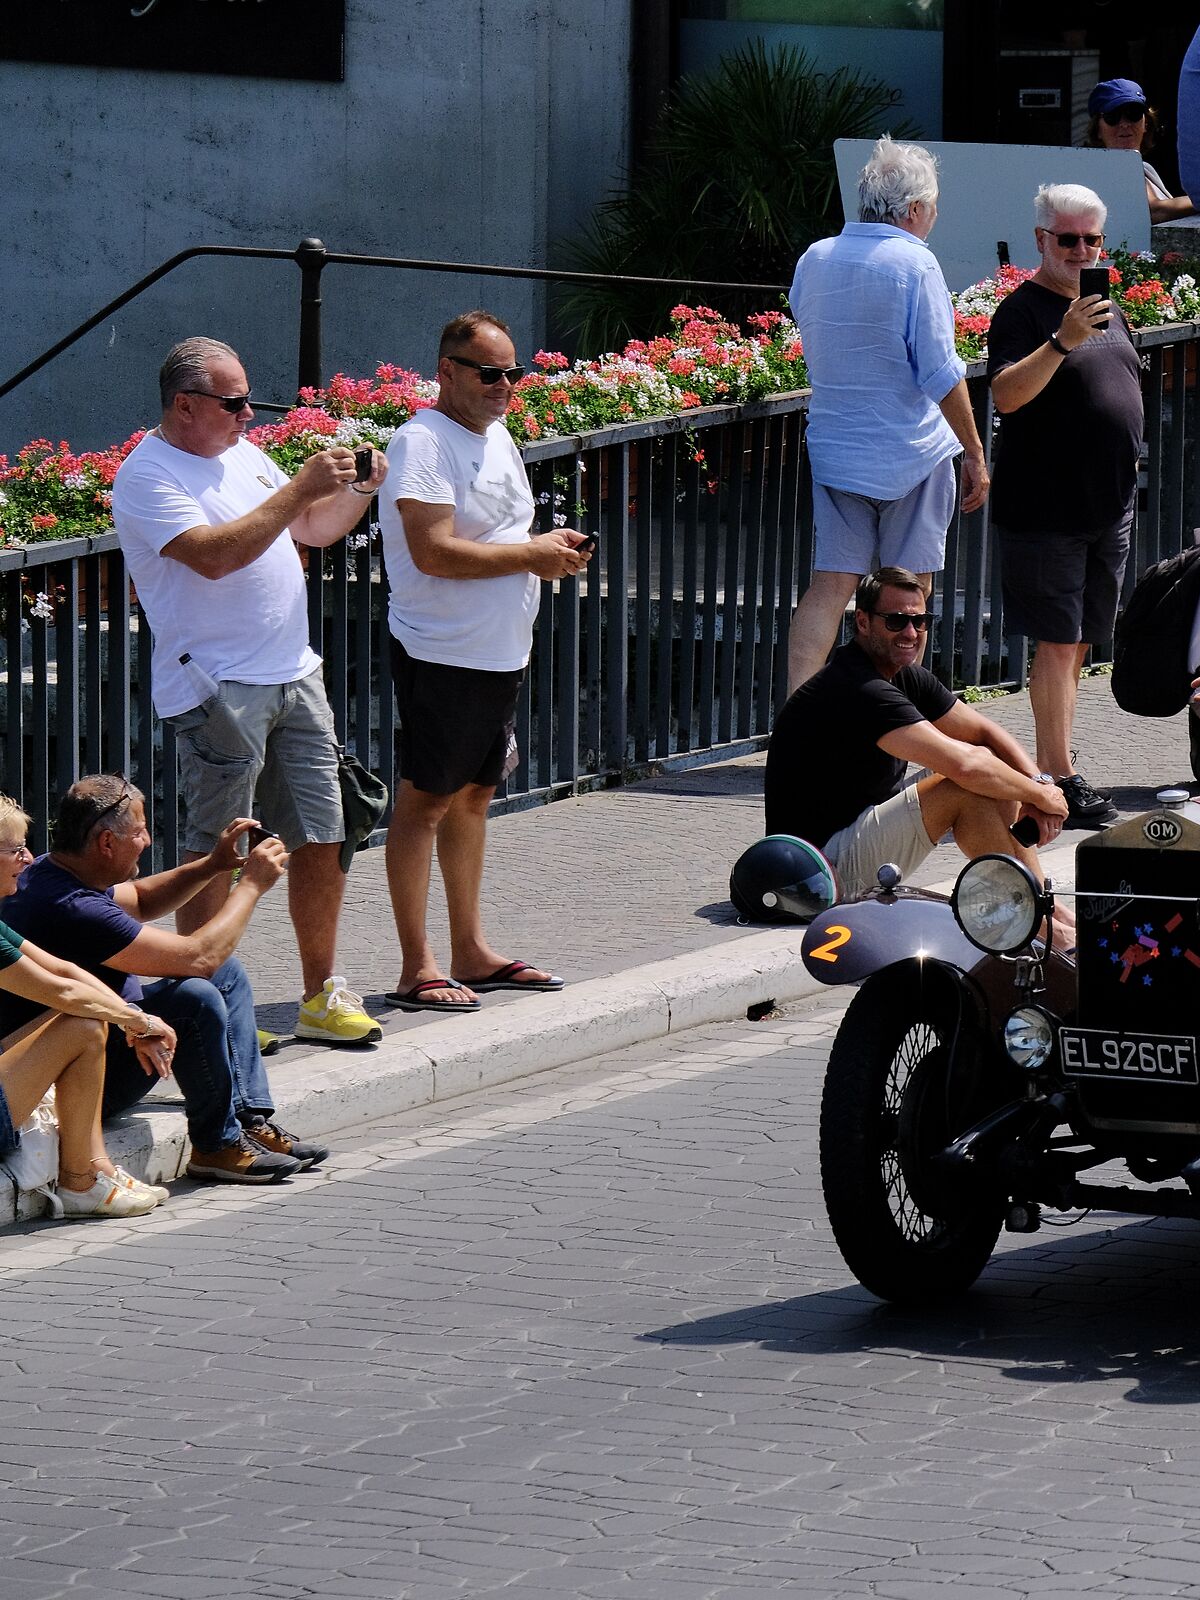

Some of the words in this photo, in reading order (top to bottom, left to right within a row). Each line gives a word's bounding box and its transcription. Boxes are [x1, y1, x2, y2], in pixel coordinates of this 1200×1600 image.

[1150, 822, 1174, 837] OM
[809, 925, 852, 963] 2
[1063, 1036, 1191, 1075] EL926CF
